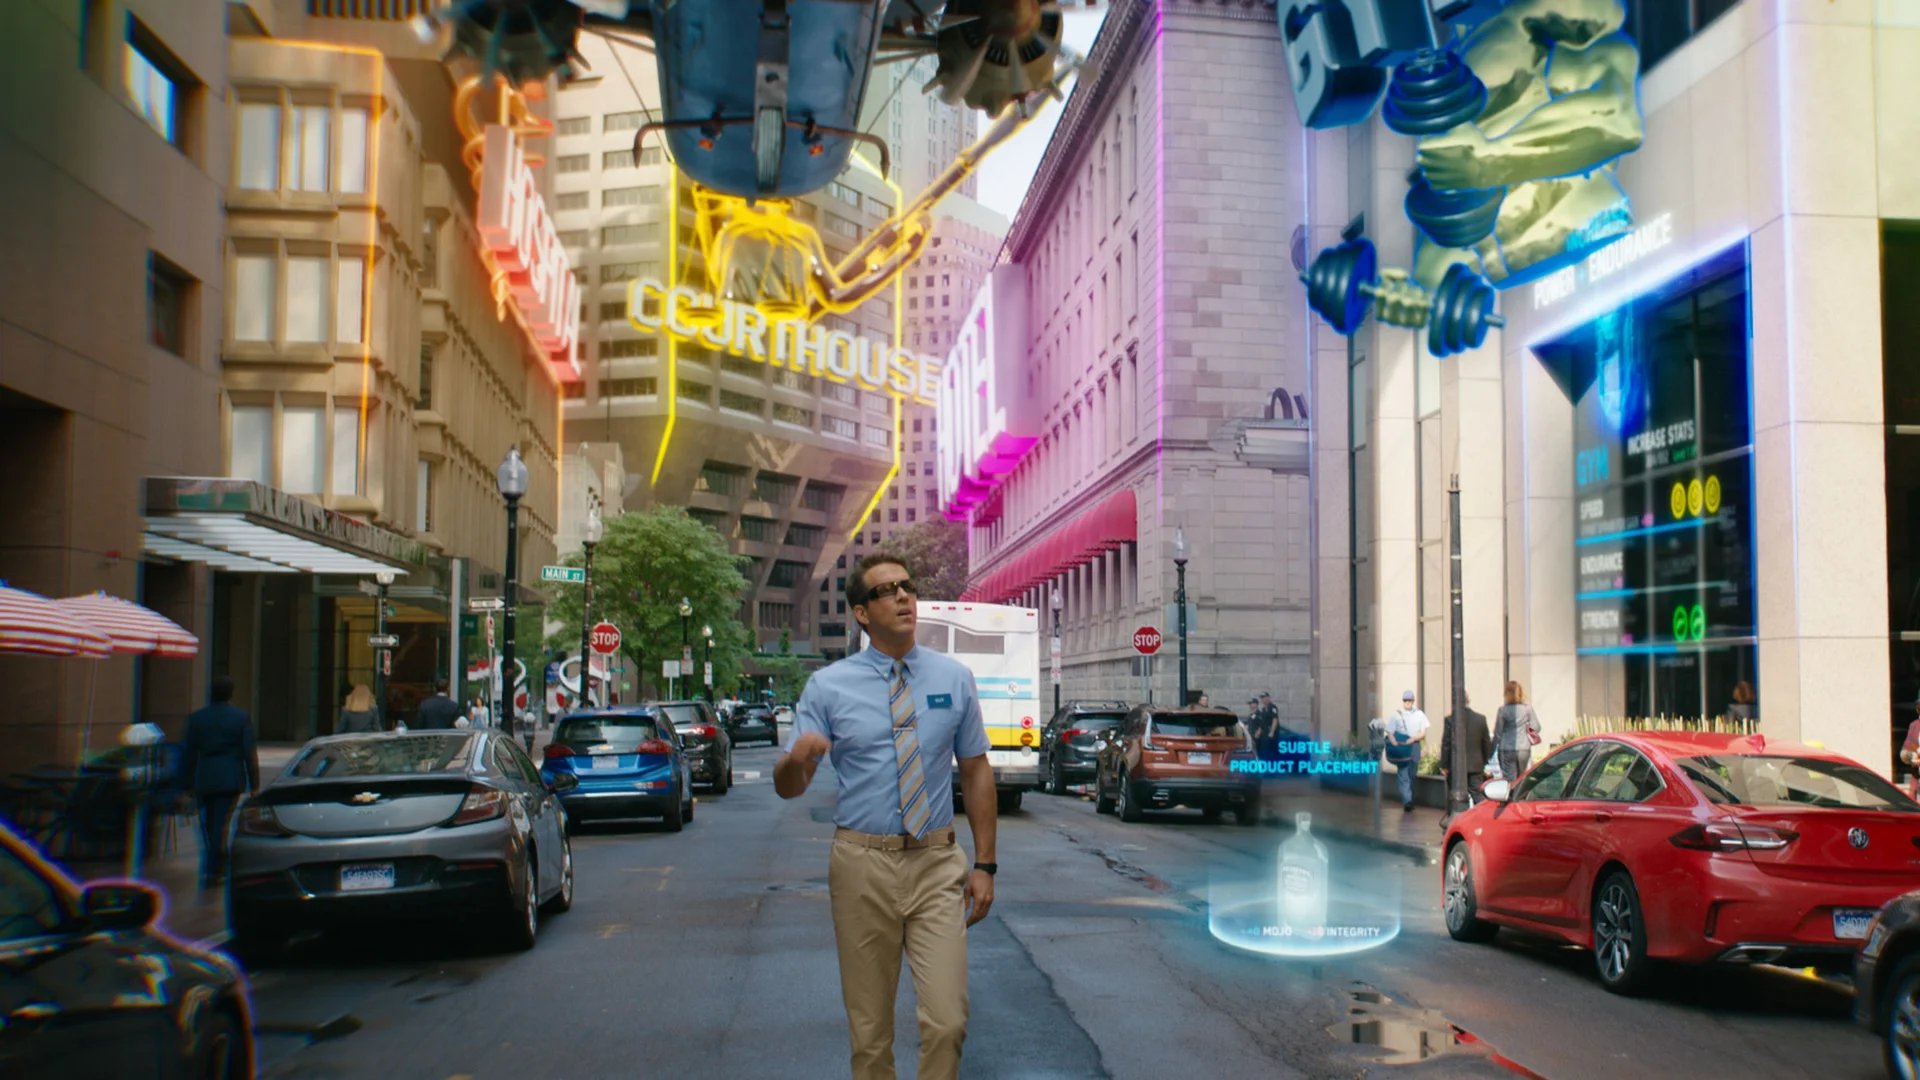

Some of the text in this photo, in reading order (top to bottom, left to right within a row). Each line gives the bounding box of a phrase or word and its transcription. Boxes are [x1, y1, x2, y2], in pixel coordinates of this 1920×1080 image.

[1589, 212, 1673, 283] ENDURANCE
[628, 275, 944, 402] COURTHOUSE
[1628, 428, 1666, 456] INCREASE
[1668, 420, 1695, 445] STATS
[1576, 445, 1609, 486] GYM
[1580, 498, 1604, 520] SPEED
[1580, 552, 1624, 575] ENDURANCE
[545, 568, 569, 580] MAIN
[1581, 610, 1619, 630] STRENGTH
[592, 632, 619, 646] STOP
[1134, 633, 1160, 648] STOP
[1278, 741, 1331, 753] SUBTLE
[1229, 760, 1379, 773] PRODUCT PLACEMENT
[1263, 926, 1293, 937] MOJO
[1326, 926, 1381, 937] INTEGRITY
